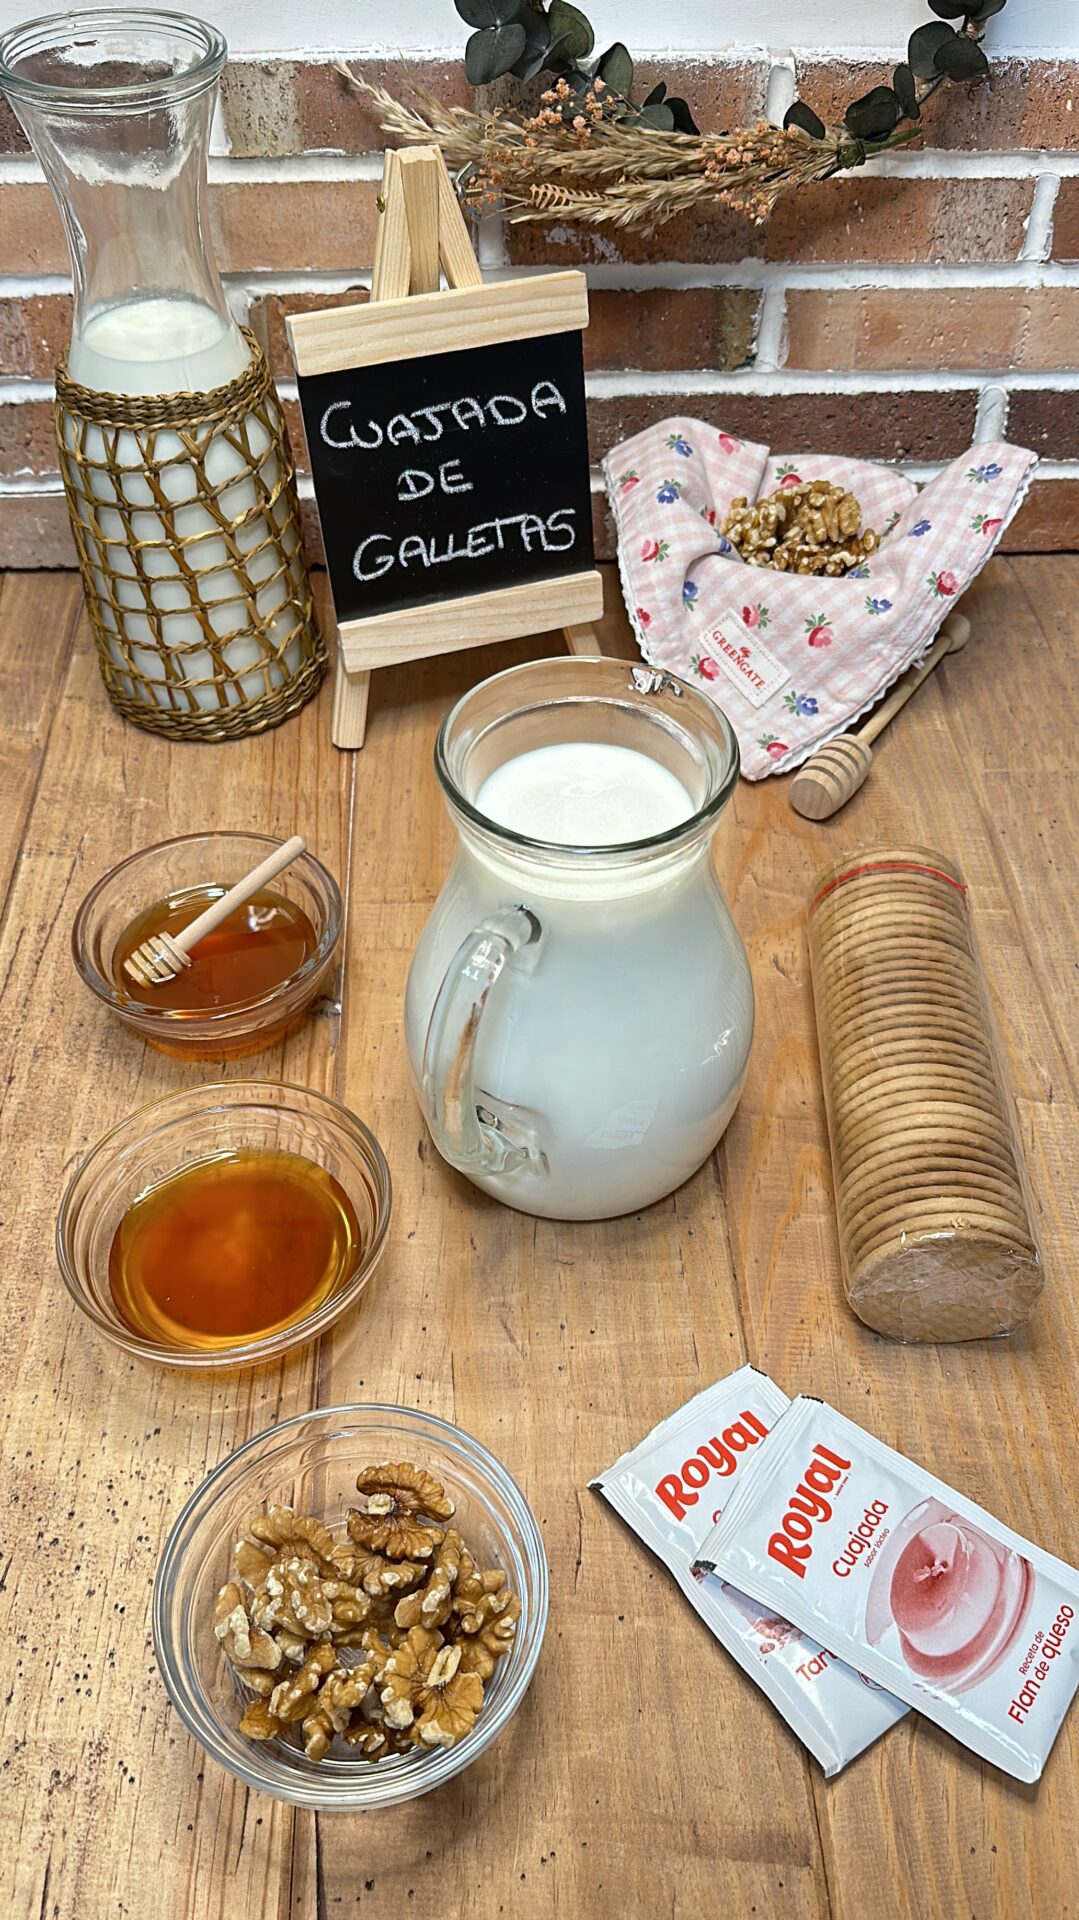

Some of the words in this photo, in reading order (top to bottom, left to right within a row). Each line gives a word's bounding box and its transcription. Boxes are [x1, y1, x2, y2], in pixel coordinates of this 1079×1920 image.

[320, 381, 567, 449] CUAJADA
[397, 459, 474, 501] DE
[352, 508, 576, 581] GALLETAS
[712, 630, 766, 690] GREENGATE
[655, 1410, 770, 1522] Royal
[767, 1444, 852, 1579] Royal
[832, 1499, 889, 1577] Cuajada
[864, 1547, 877, 1568] sabor
[1018, 1643, 1039, 1675] Receta
[1034, 1630, 1045, 1645] de
[1041, 1605, 1074, 1660] queso
[1034, 1660, 1050, 1681] de
[1008, 1679, 1041, 1724] Flan
